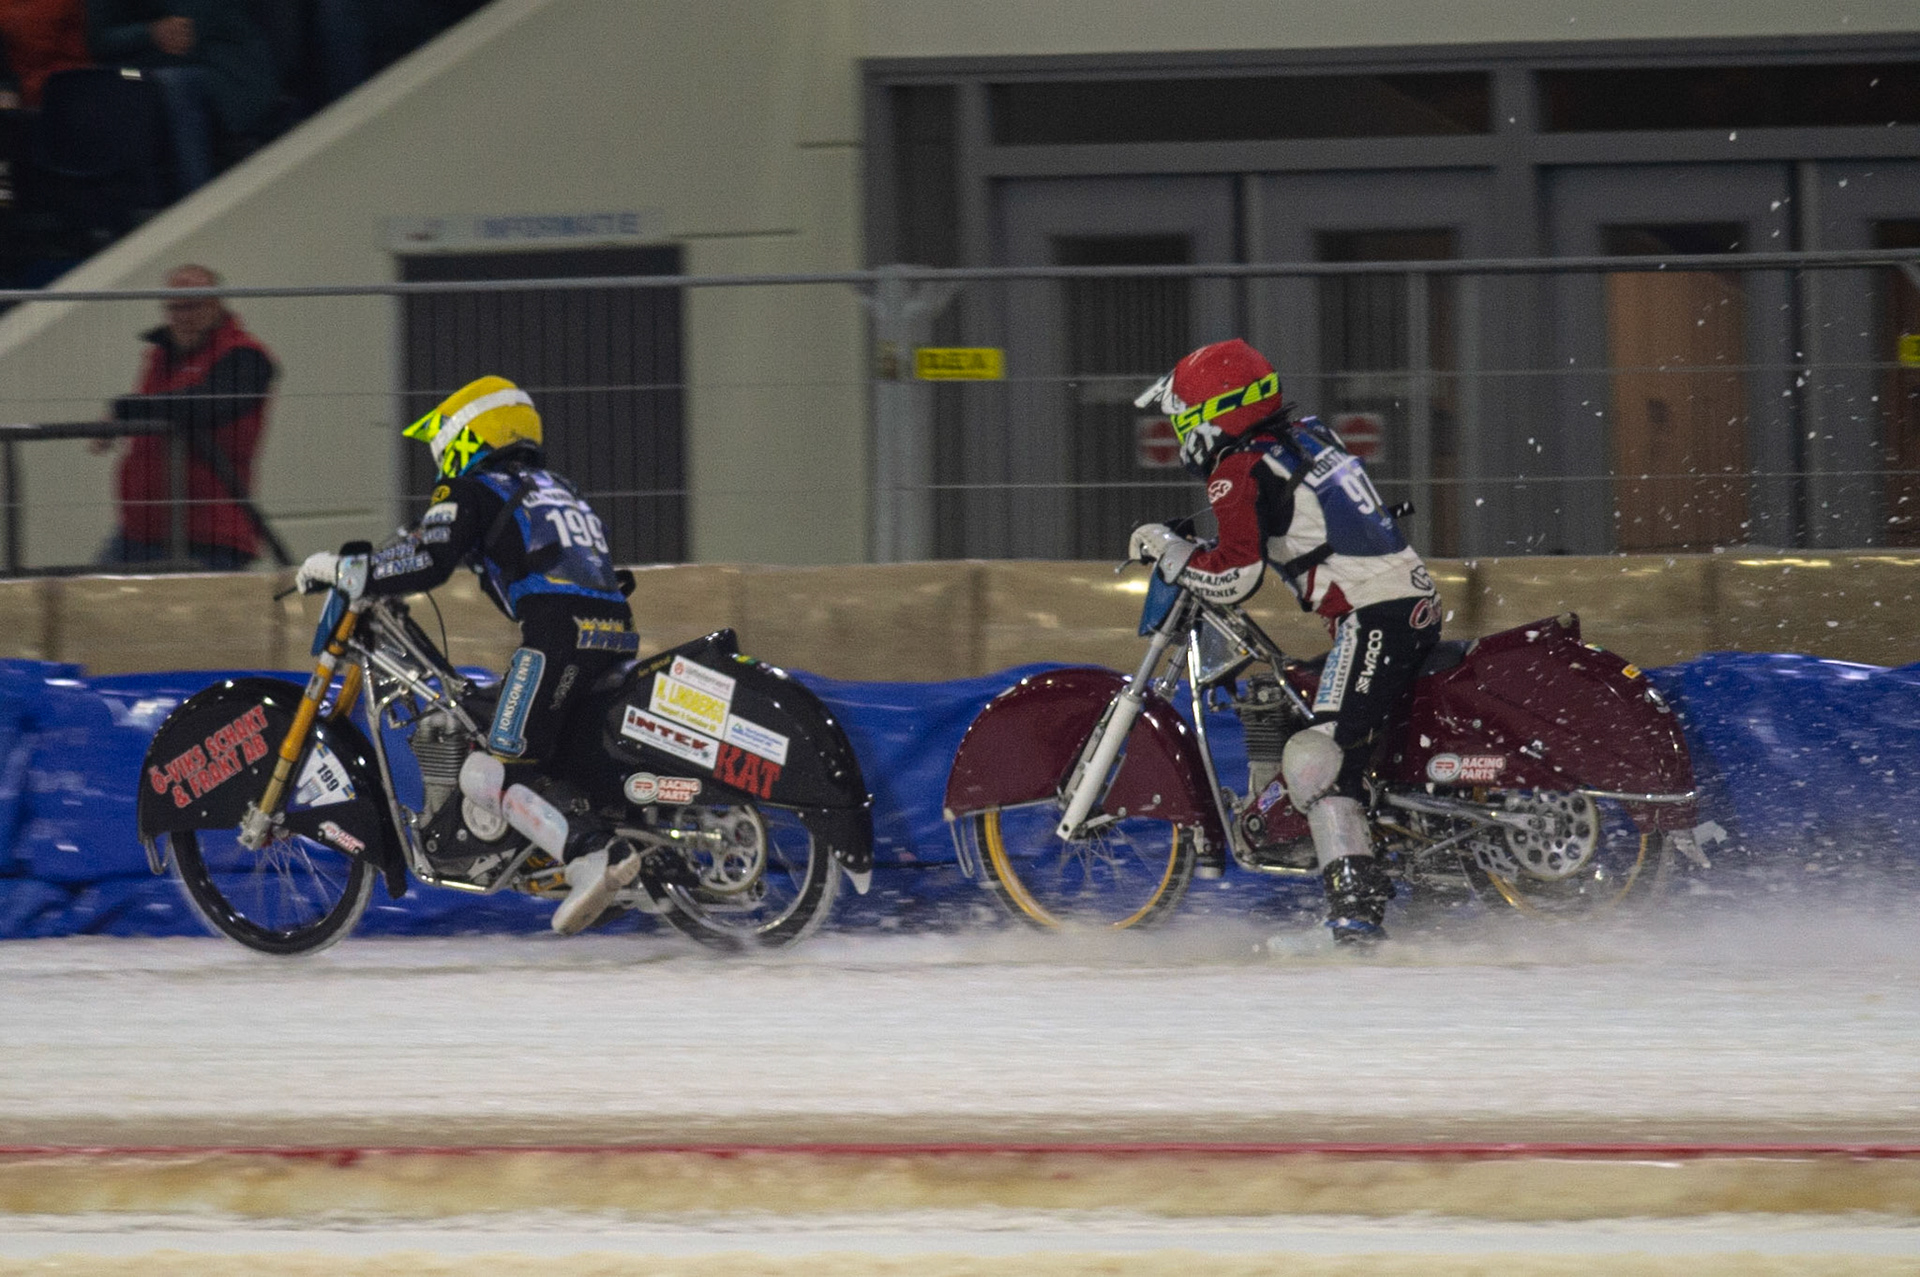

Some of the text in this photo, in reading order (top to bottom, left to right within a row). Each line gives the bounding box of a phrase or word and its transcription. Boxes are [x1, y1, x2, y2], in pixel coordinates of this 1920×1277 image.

[545, 507, 609, 554] 199
[1361, 629, 1383, 676] WACO
[204, 704, 269, 760] SCHAKT
[172, 733, 269, 809] & FRAKT AB
[316, 763, 340, 792] 199
[713, 741, 782, 800] KAT
[1460, 768, 1495, 780] PARTS
[1462, 757, 1504, 769] RACING
[659, 779, 700, 792] RACING
[659, 790, 691, 802] PARTS
